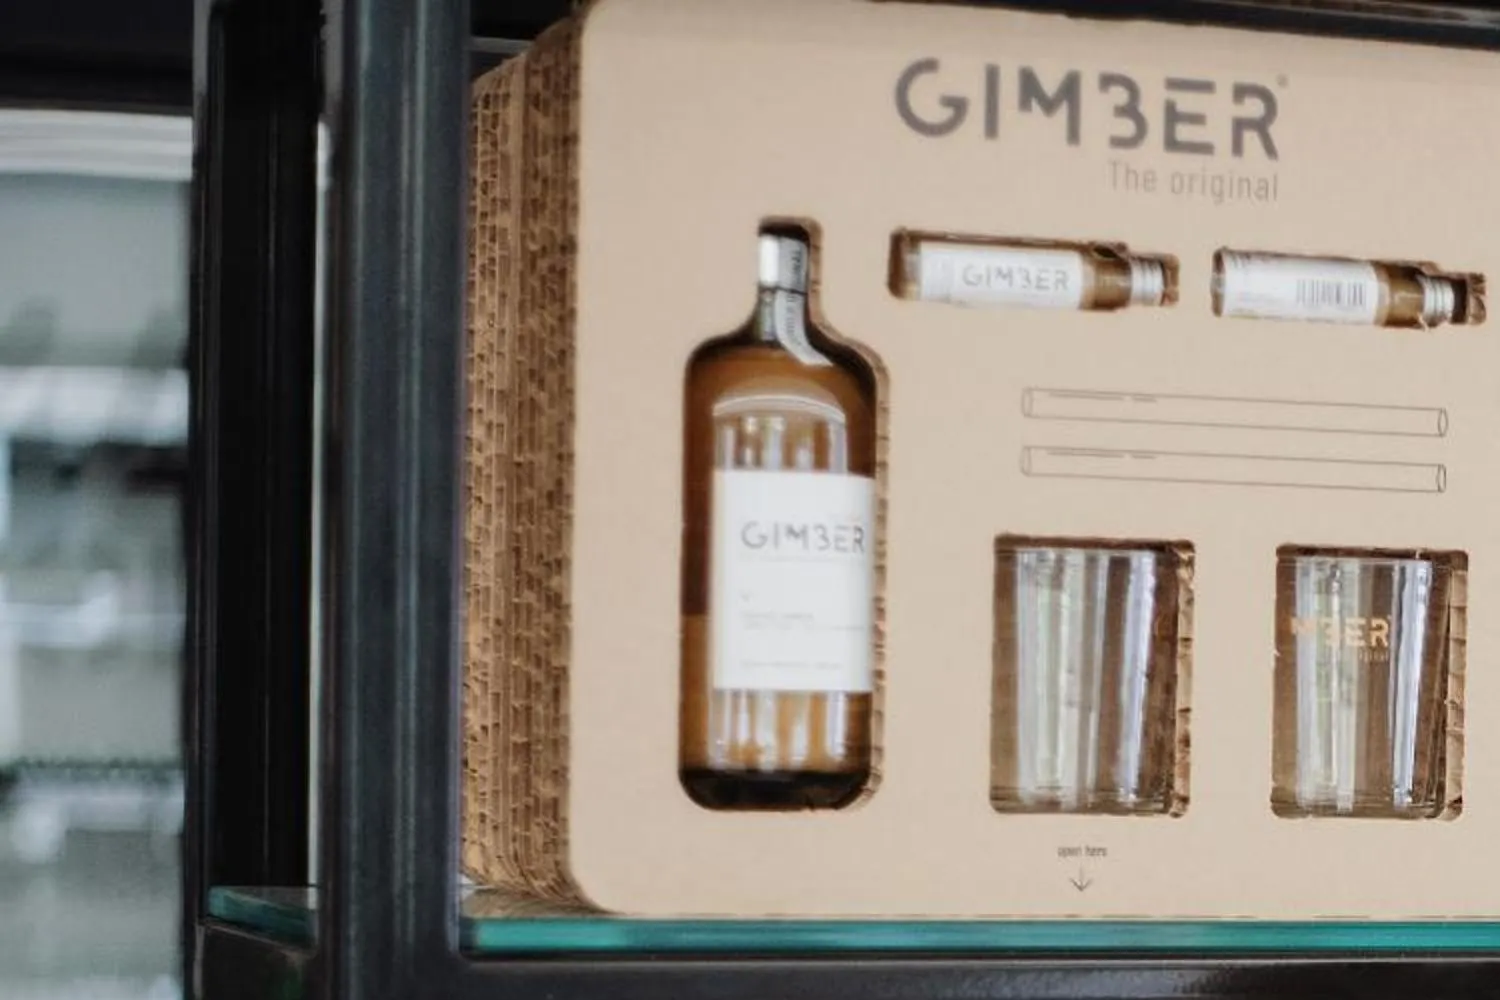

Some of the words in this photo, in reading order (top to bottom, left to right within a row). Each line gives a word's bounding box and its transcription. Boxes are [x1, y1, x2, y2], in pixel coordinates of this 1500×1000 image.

[895, 57, 1279, 161] GIMBER
[1108, 160, 1158, 193] The
[1170, 168, 1279, 205] original
[962, 262, 1069, 291] GIMBER
[741, 521, 866, 552] GIMBER
